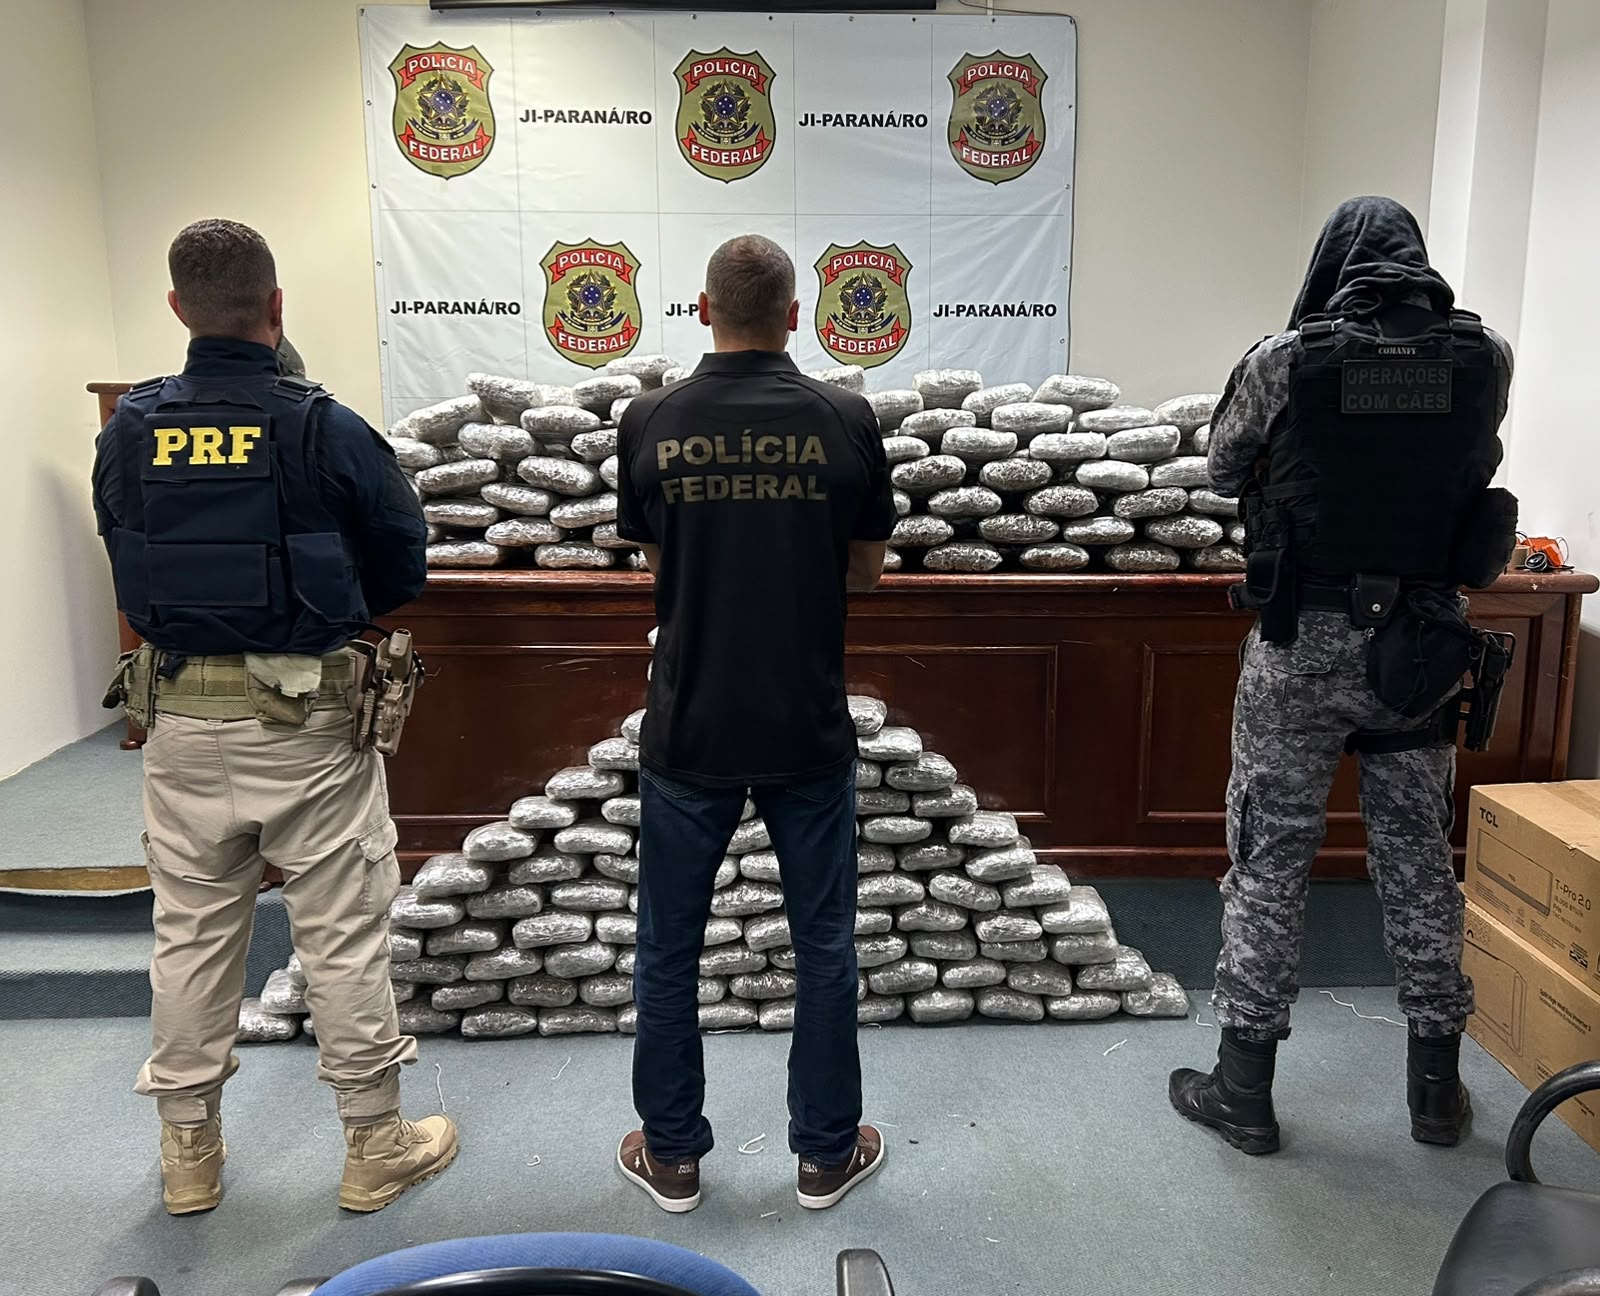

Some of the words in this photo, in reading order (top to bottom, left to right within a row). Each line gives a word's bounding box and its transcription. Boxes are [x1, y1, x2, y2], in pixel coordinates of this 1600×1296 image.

[519, 107, 653, 125] JI-PARANÁ/RO
[798, 110, 929, 128] JI-PARANÁ/RO
[409, 141, 482, 161] FEDERAL
[691, 143, 762, 164] FEDERAL
[962, 145, 1031, 167] FEDERAL
[390, 298, 521, 316] JI-PARANÁ/RO
[933, 300, 1057, 318] JI-PARANÁ/RO
[558, 332, 629, 352] FEDERAL
[829, 333, 898, 354] FEDERAL
[1346, 393, 1389, 409] COM
[152, 426, 261, 465] PRF
[656, 429, 828, 470] POLÍCIA
[661, 474, 827, 505] FEDERAL
[1479, 806, 1498, 828] TCL
[1555, 879, 1577, 902] T-Pro
